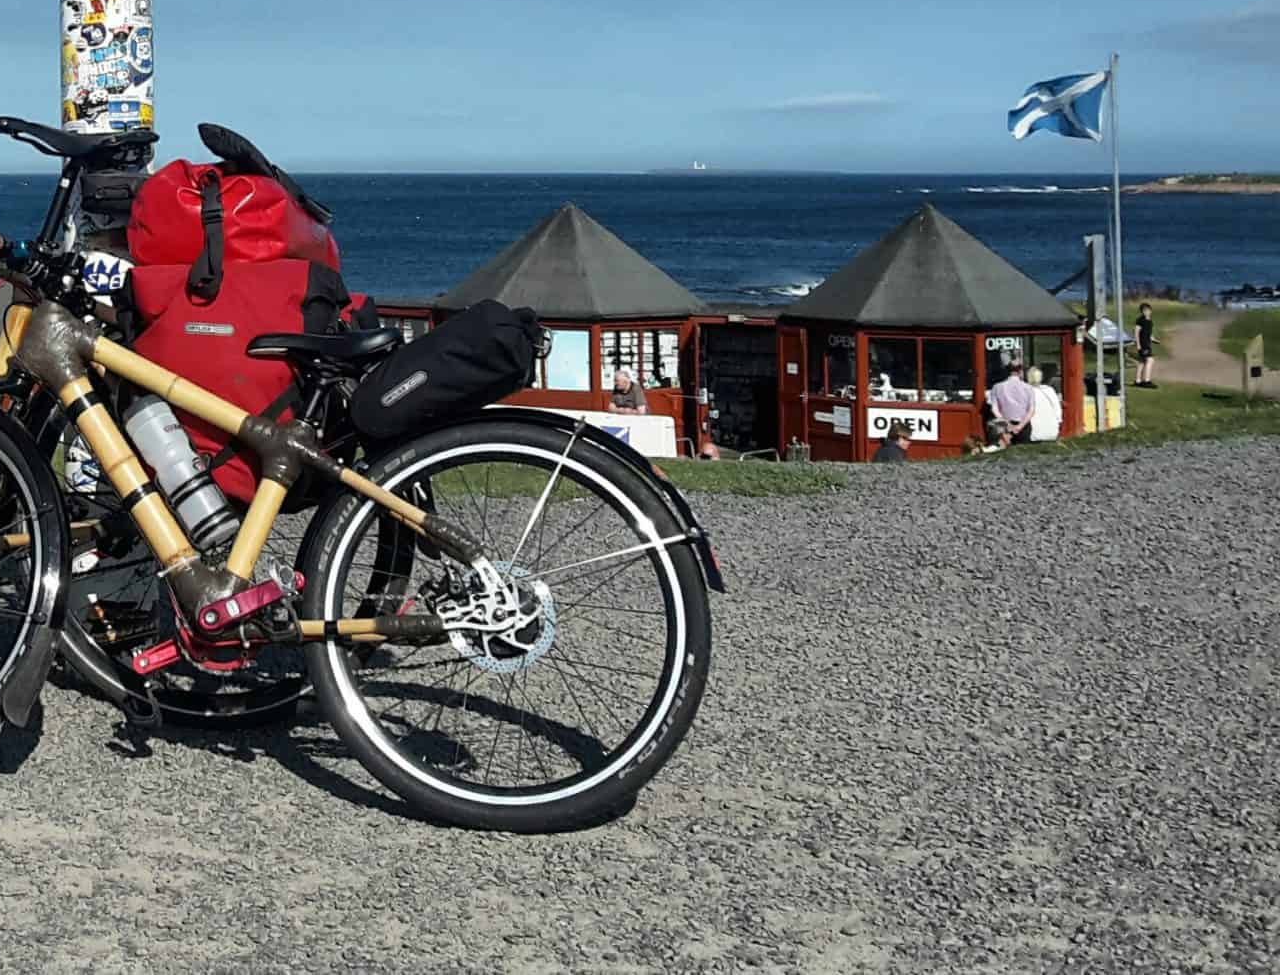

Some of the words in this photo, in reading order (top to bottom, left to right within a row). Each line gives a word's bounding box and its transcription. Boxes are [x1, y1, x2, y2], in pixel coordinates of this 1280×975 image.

[985, 337, 1021, 351] OPEN
[873, 416, 932, 433] OPEN
[318, 448, 418, 572] SCHWLBE
